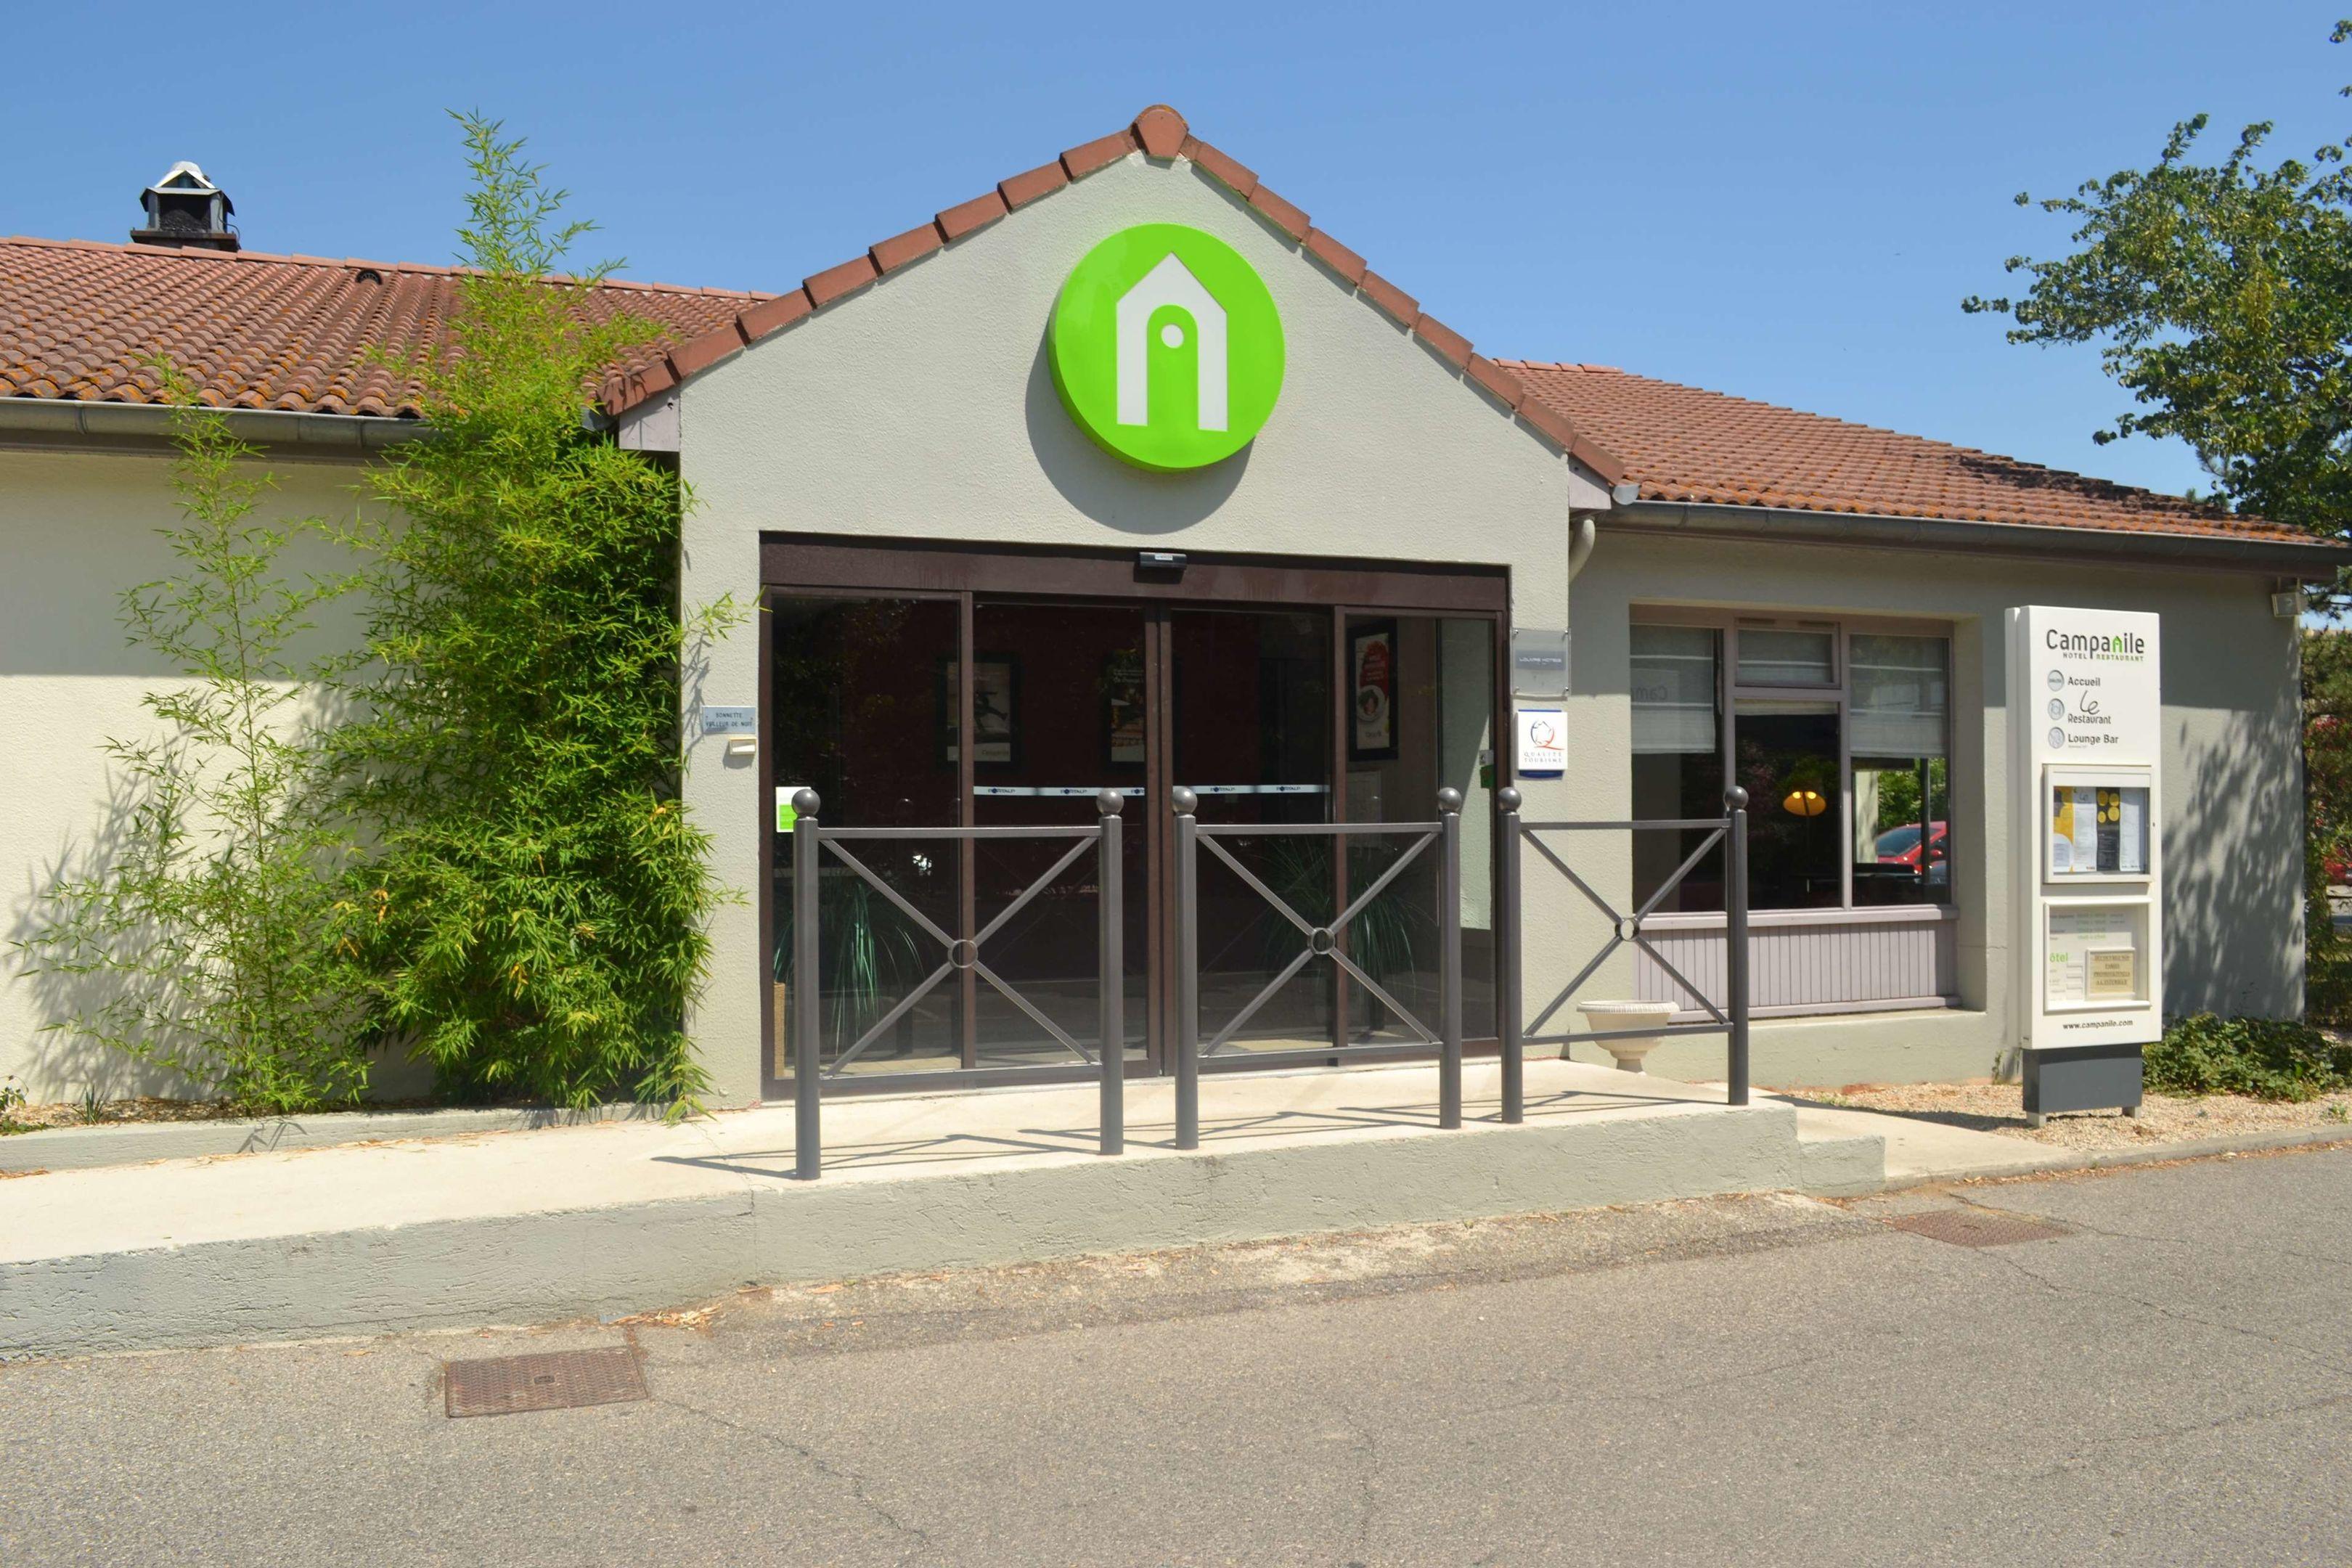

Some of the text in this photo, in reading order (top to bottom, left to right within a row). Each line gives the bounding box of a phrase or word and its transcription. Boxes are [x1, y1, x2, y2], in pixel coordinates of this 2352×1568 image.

[2046, 629, 2145, 659] Campanile
[2067, 677, 2101, 687] Accueil
[2067, 714, 2112, 725] Restaurant
[2067, 734, 2119, 745] Lounge Bar
[2062, 1020, 2133, 1030] www.campanile.com
